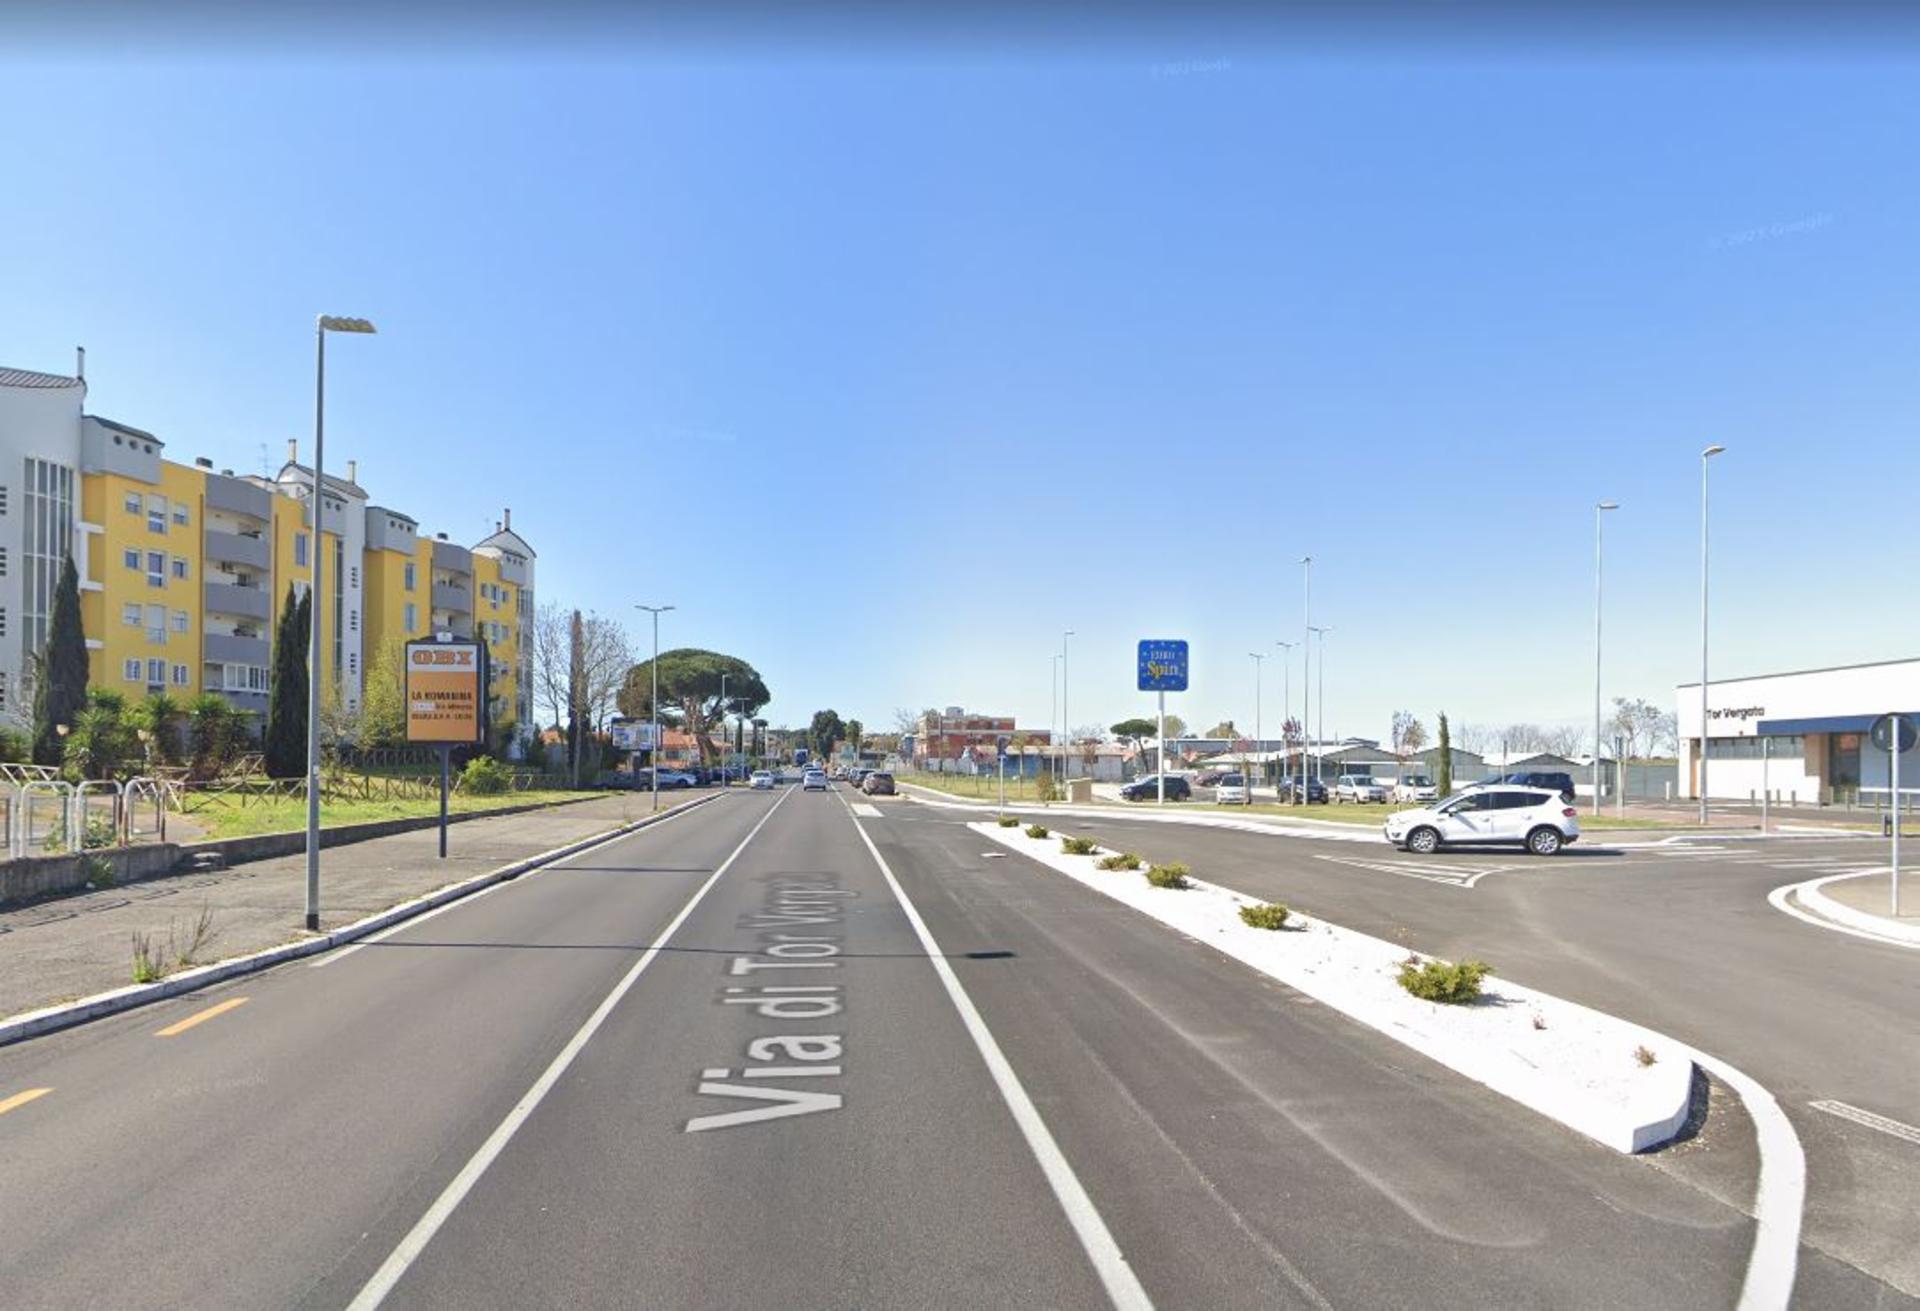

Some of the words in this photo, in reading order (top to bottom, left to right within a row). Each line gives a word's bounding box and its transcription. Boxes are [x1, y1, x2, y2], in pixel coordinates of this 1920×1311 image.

[412, 650, 473, 665] OBI
[1147, 660, 1179, 680] Spin
[1723, 706, 1765, 721] Vergata
